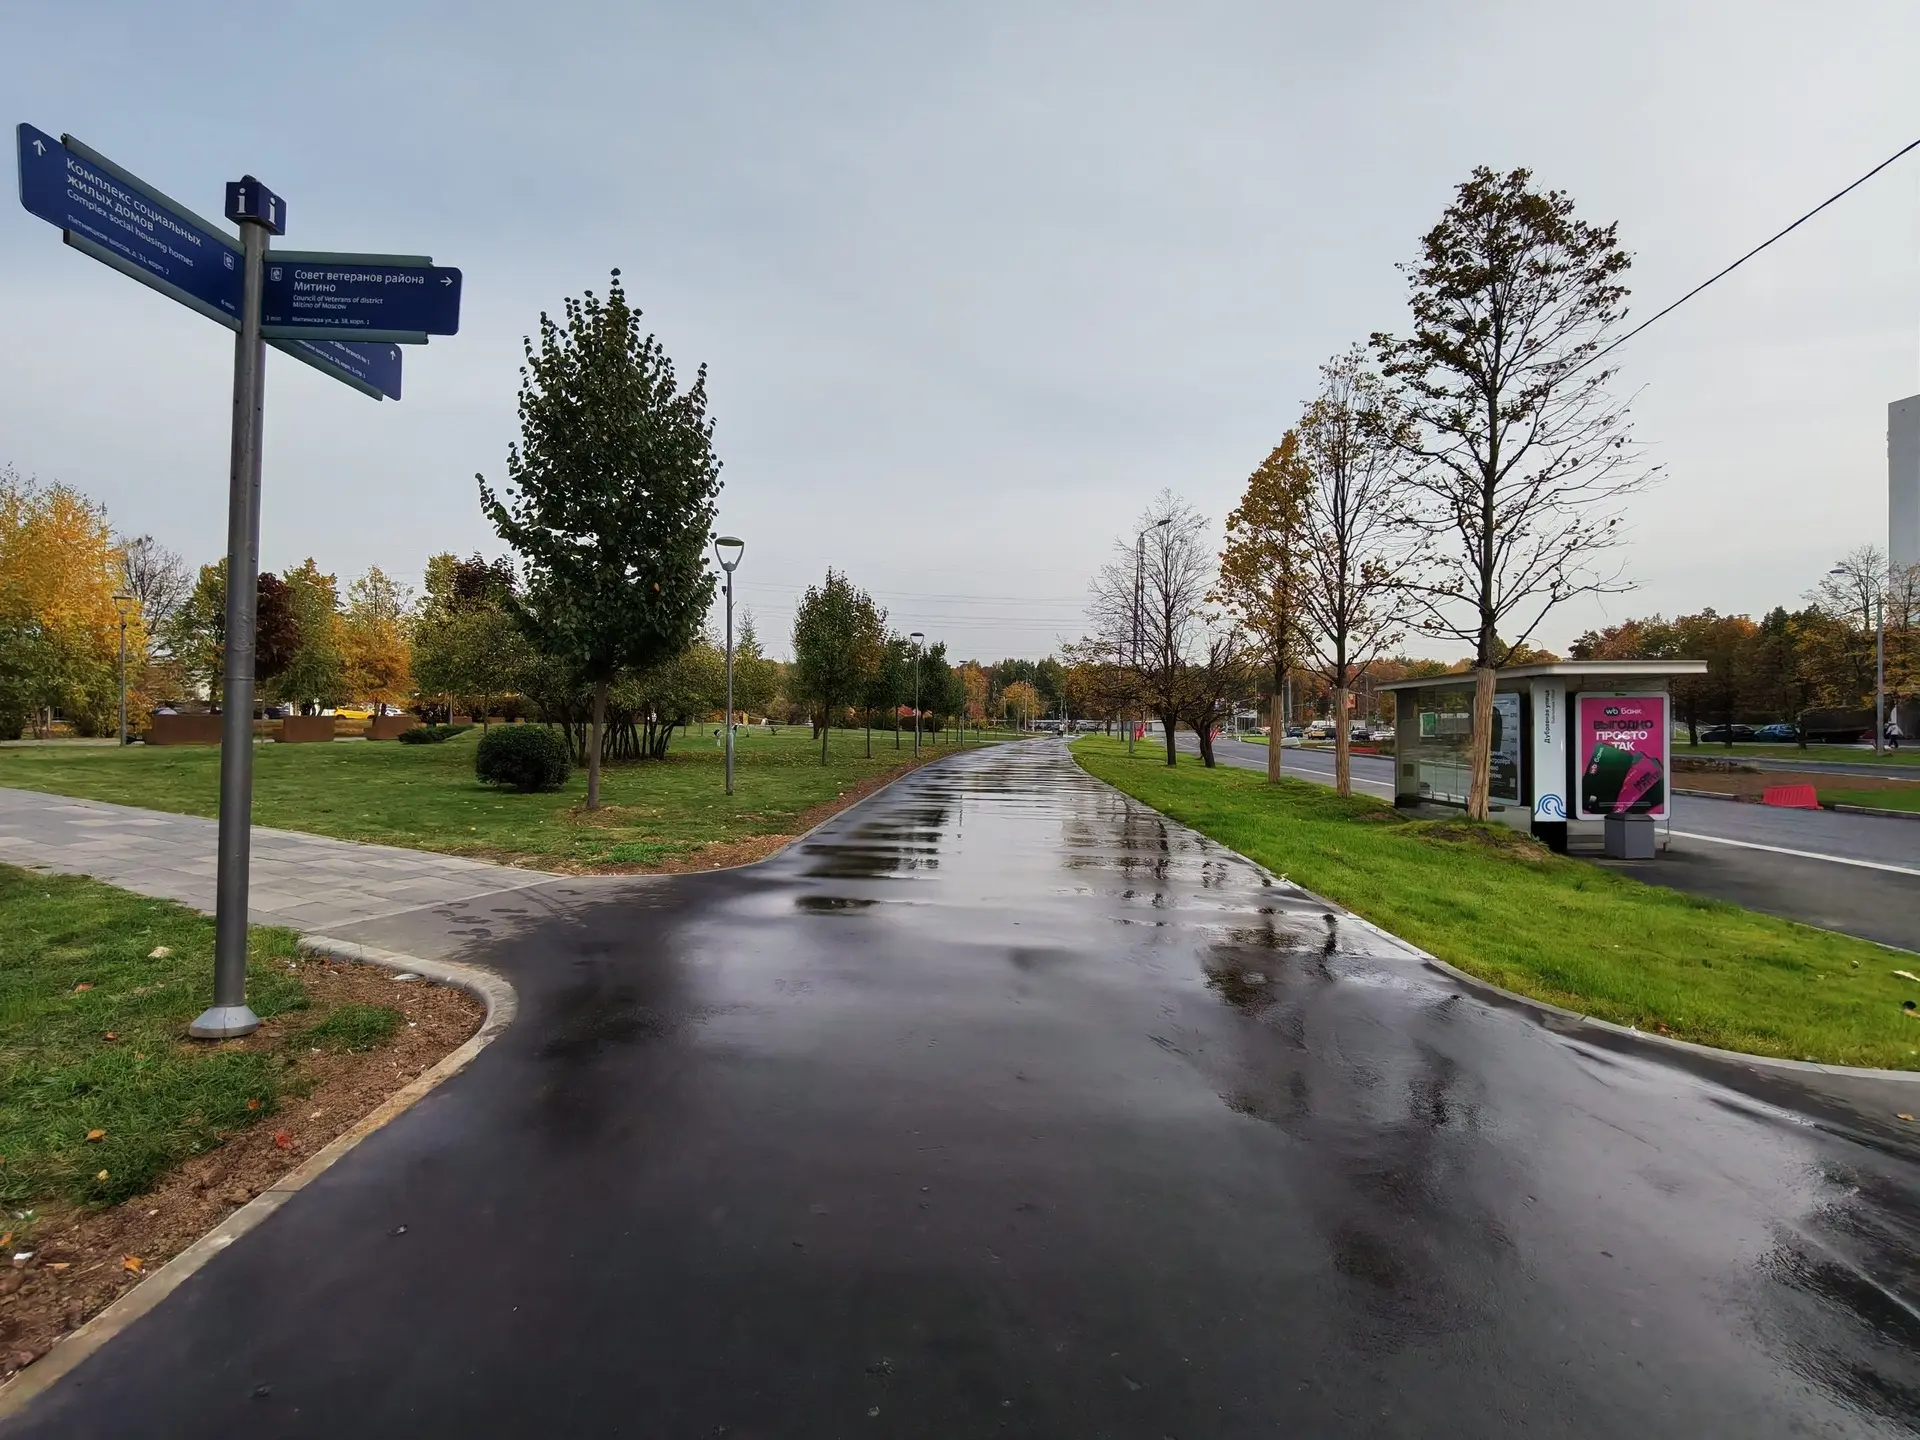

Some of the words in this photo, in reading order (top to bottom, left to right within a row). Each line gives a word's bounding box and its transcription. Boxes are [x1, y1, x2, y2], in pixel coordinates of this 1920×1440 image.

[66, 157, 131, 205] Комплекс
[133, 201, 202, 247] социальных
[66, 173, 113, 208] жилых
[115, 203, 154, 232] домов
[66, 189, 108, 218] Complex
[108, 213, 134, 233] social
[135, 227, 168, 254] housing
[168, 245, 194, 267] homes
[294, 269, 325, 280] Совет
[326, 272, 383, 284] ветеранов
[384, 273, 425, 285] района
[293, 281, 337, 292] Митино
[292, 294, 316, 302] Council
[360, 297, 384, 305] district
[321, 302, 347, 310] Moscow
[1605, 707, 1619, 715] wb
[1620, 706, 1642, 715] банк
[1543, 708, 1551, 744] Дубравная
[1593, 720, 1653, 731] ВЫГОДНО
[1595, 730, 1648, 741] ПРОСТО
[1610, 741, 1637, 751] ТАК
